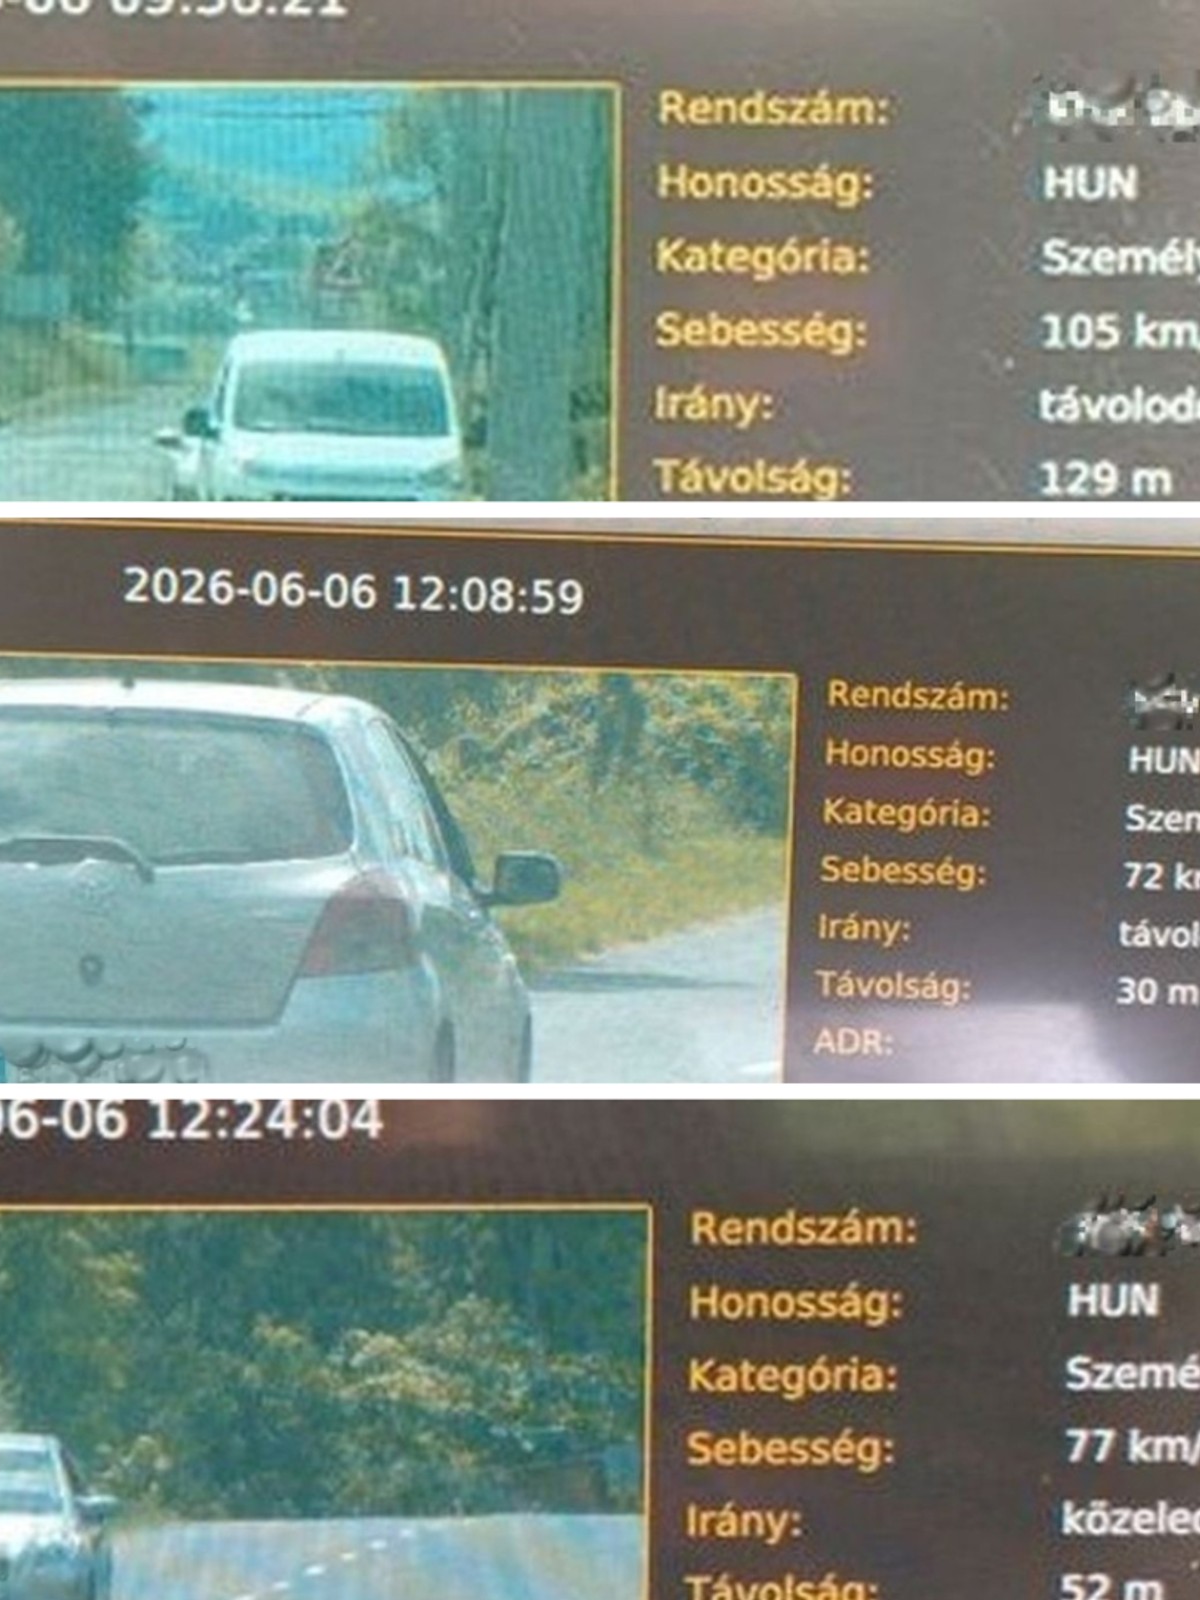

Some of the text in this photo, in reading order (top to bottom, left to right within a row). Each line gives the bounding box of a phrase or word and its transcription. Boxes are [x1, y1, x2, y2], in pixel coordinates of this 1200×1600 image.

[658, 88, 889, 126] Rendszám:
[657, 162, 1138, 208] Honosság: HUN
[656, 236, 1200, 282] Kategória: Személ
[655, 310, 1200, 356] Sebesség: 105 km
[654, 383, 1200, 430] Irány: távolod
[653, 457, 1173, 500] Távolság: 129 m
[123, 565, 584, 616] 2026-06-06 12:08:59
[828, 678, 1009, 711] Rendszám:
[825, 739, 1200, 776] Honosság: HUN
[823, 797, 990, 833] Kategória:
[820, 854, 987, 891] Sebesség:
[1123, 861, 1164, 891] 72
[818, 912, 910, 949] Irány:
[816, 969, 1199, 1006] Távolság: 30 m
[813, 1027, 893, 1056] ADR:
[148, 1098, 385, 1140] 12:24:04
[691, 1207, 917, 1246] Rendszám:
[690, 1281, 1160, 1327] Honosság: HUN
[688, 1355, 898, 1400] Kategória:
[687, 1428, 895, 1473] Sebesség:
[1065, 1427, 1117, 1463] 77
[686, 1501, 802, 1545] Irány:
[1061, 1572, 1112, 1600] 52
[1124, 1579, 1165, 1600] m
